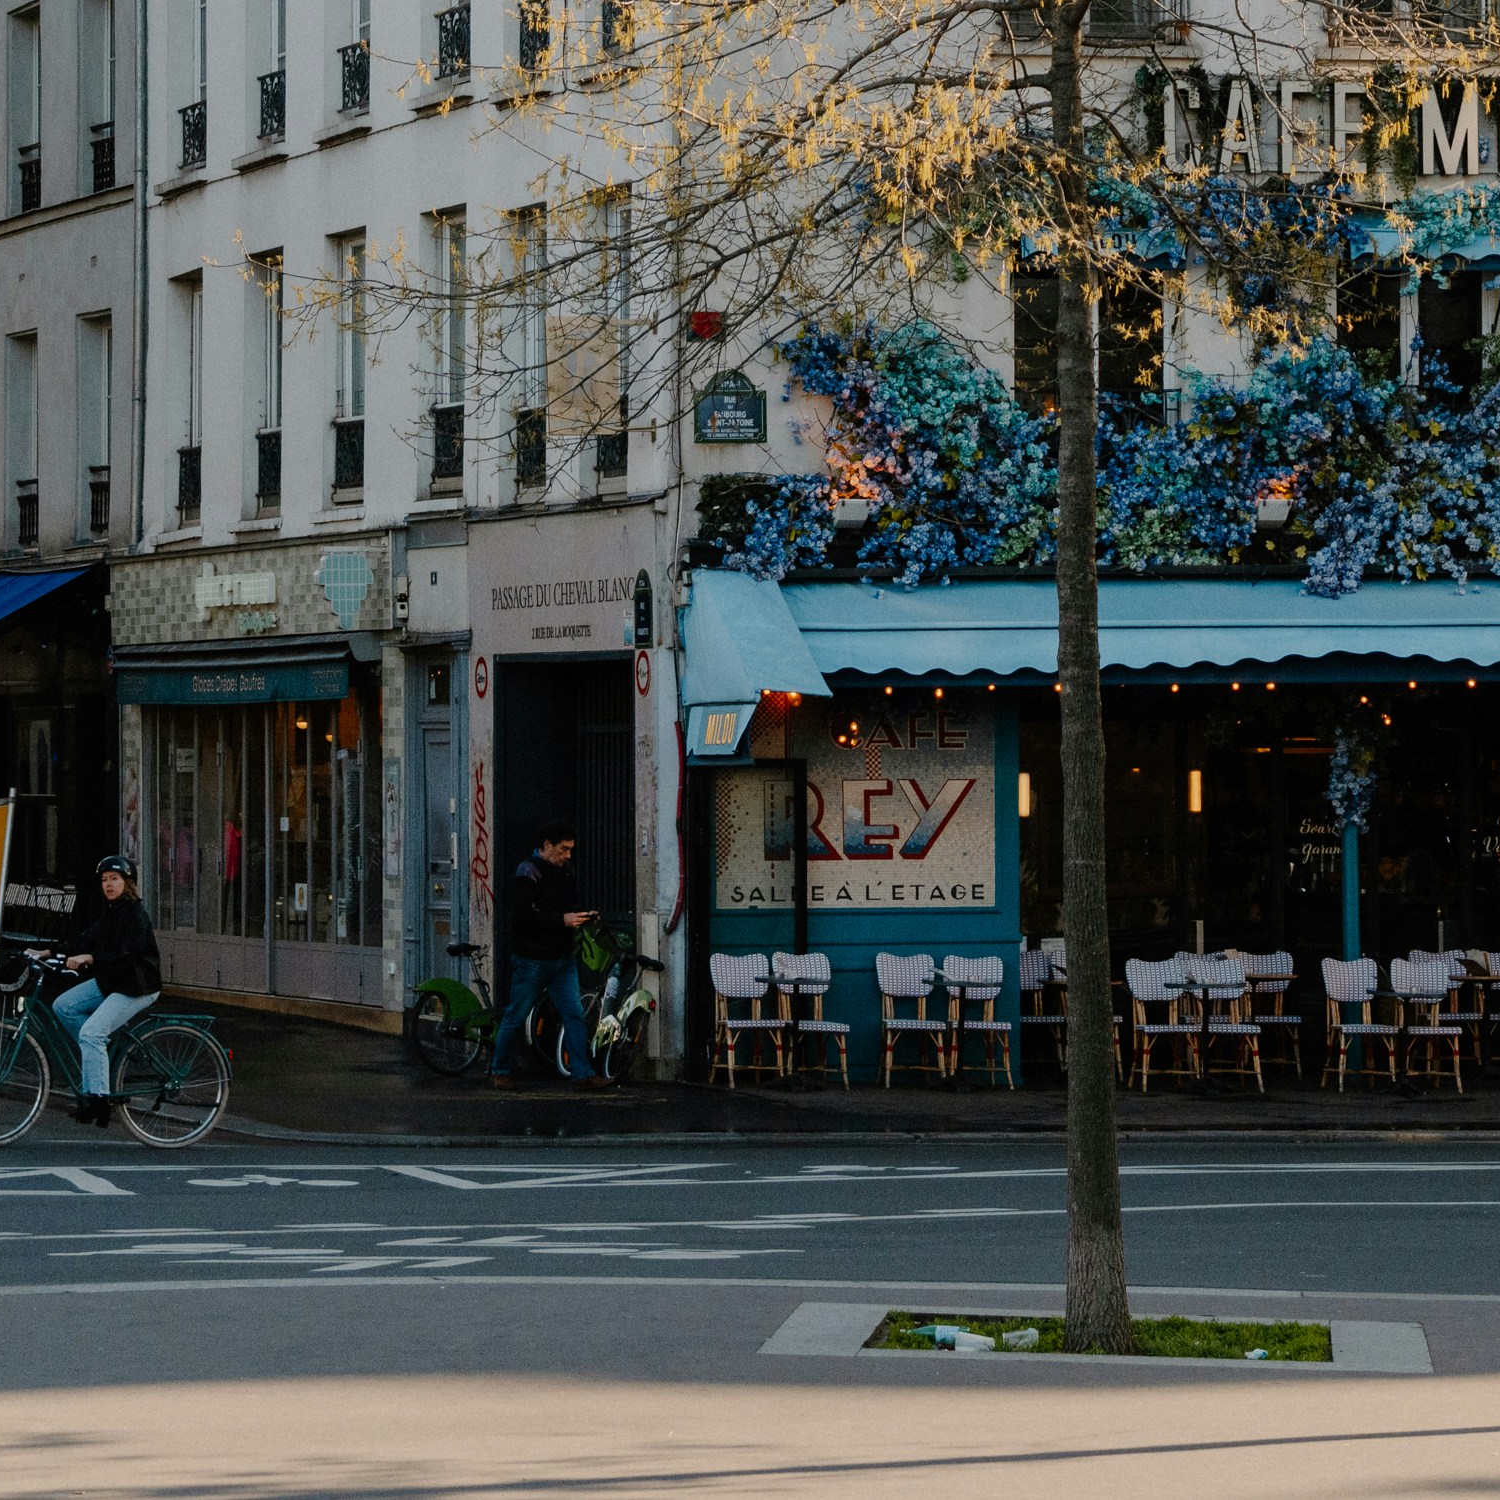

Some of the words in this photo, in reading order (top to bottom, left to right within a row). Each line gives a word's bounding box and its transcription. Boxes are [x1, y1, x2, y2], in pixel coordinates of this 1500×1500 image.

[724, 395, 736, 404] RUE
[707, 419, 754, 427] SINT-ANTOINE
[492, 585, 534, 611] PASSAGE
[536, 583, 551, 608] DU
[553, 579, 596, 607] CHEVAL
[597, 576, 636, 604] BLANC
[535, 626, 546, 640] RUE
[546, 626, 554, 639] DE
[554, 626, 562, 639] LA
[562, 624, 592, 641] ROQUETTE
[704, 713, 737, 745] MILOU
[828, 709, 970, 750] CAFE
[763, 778, 978, 861] REY
